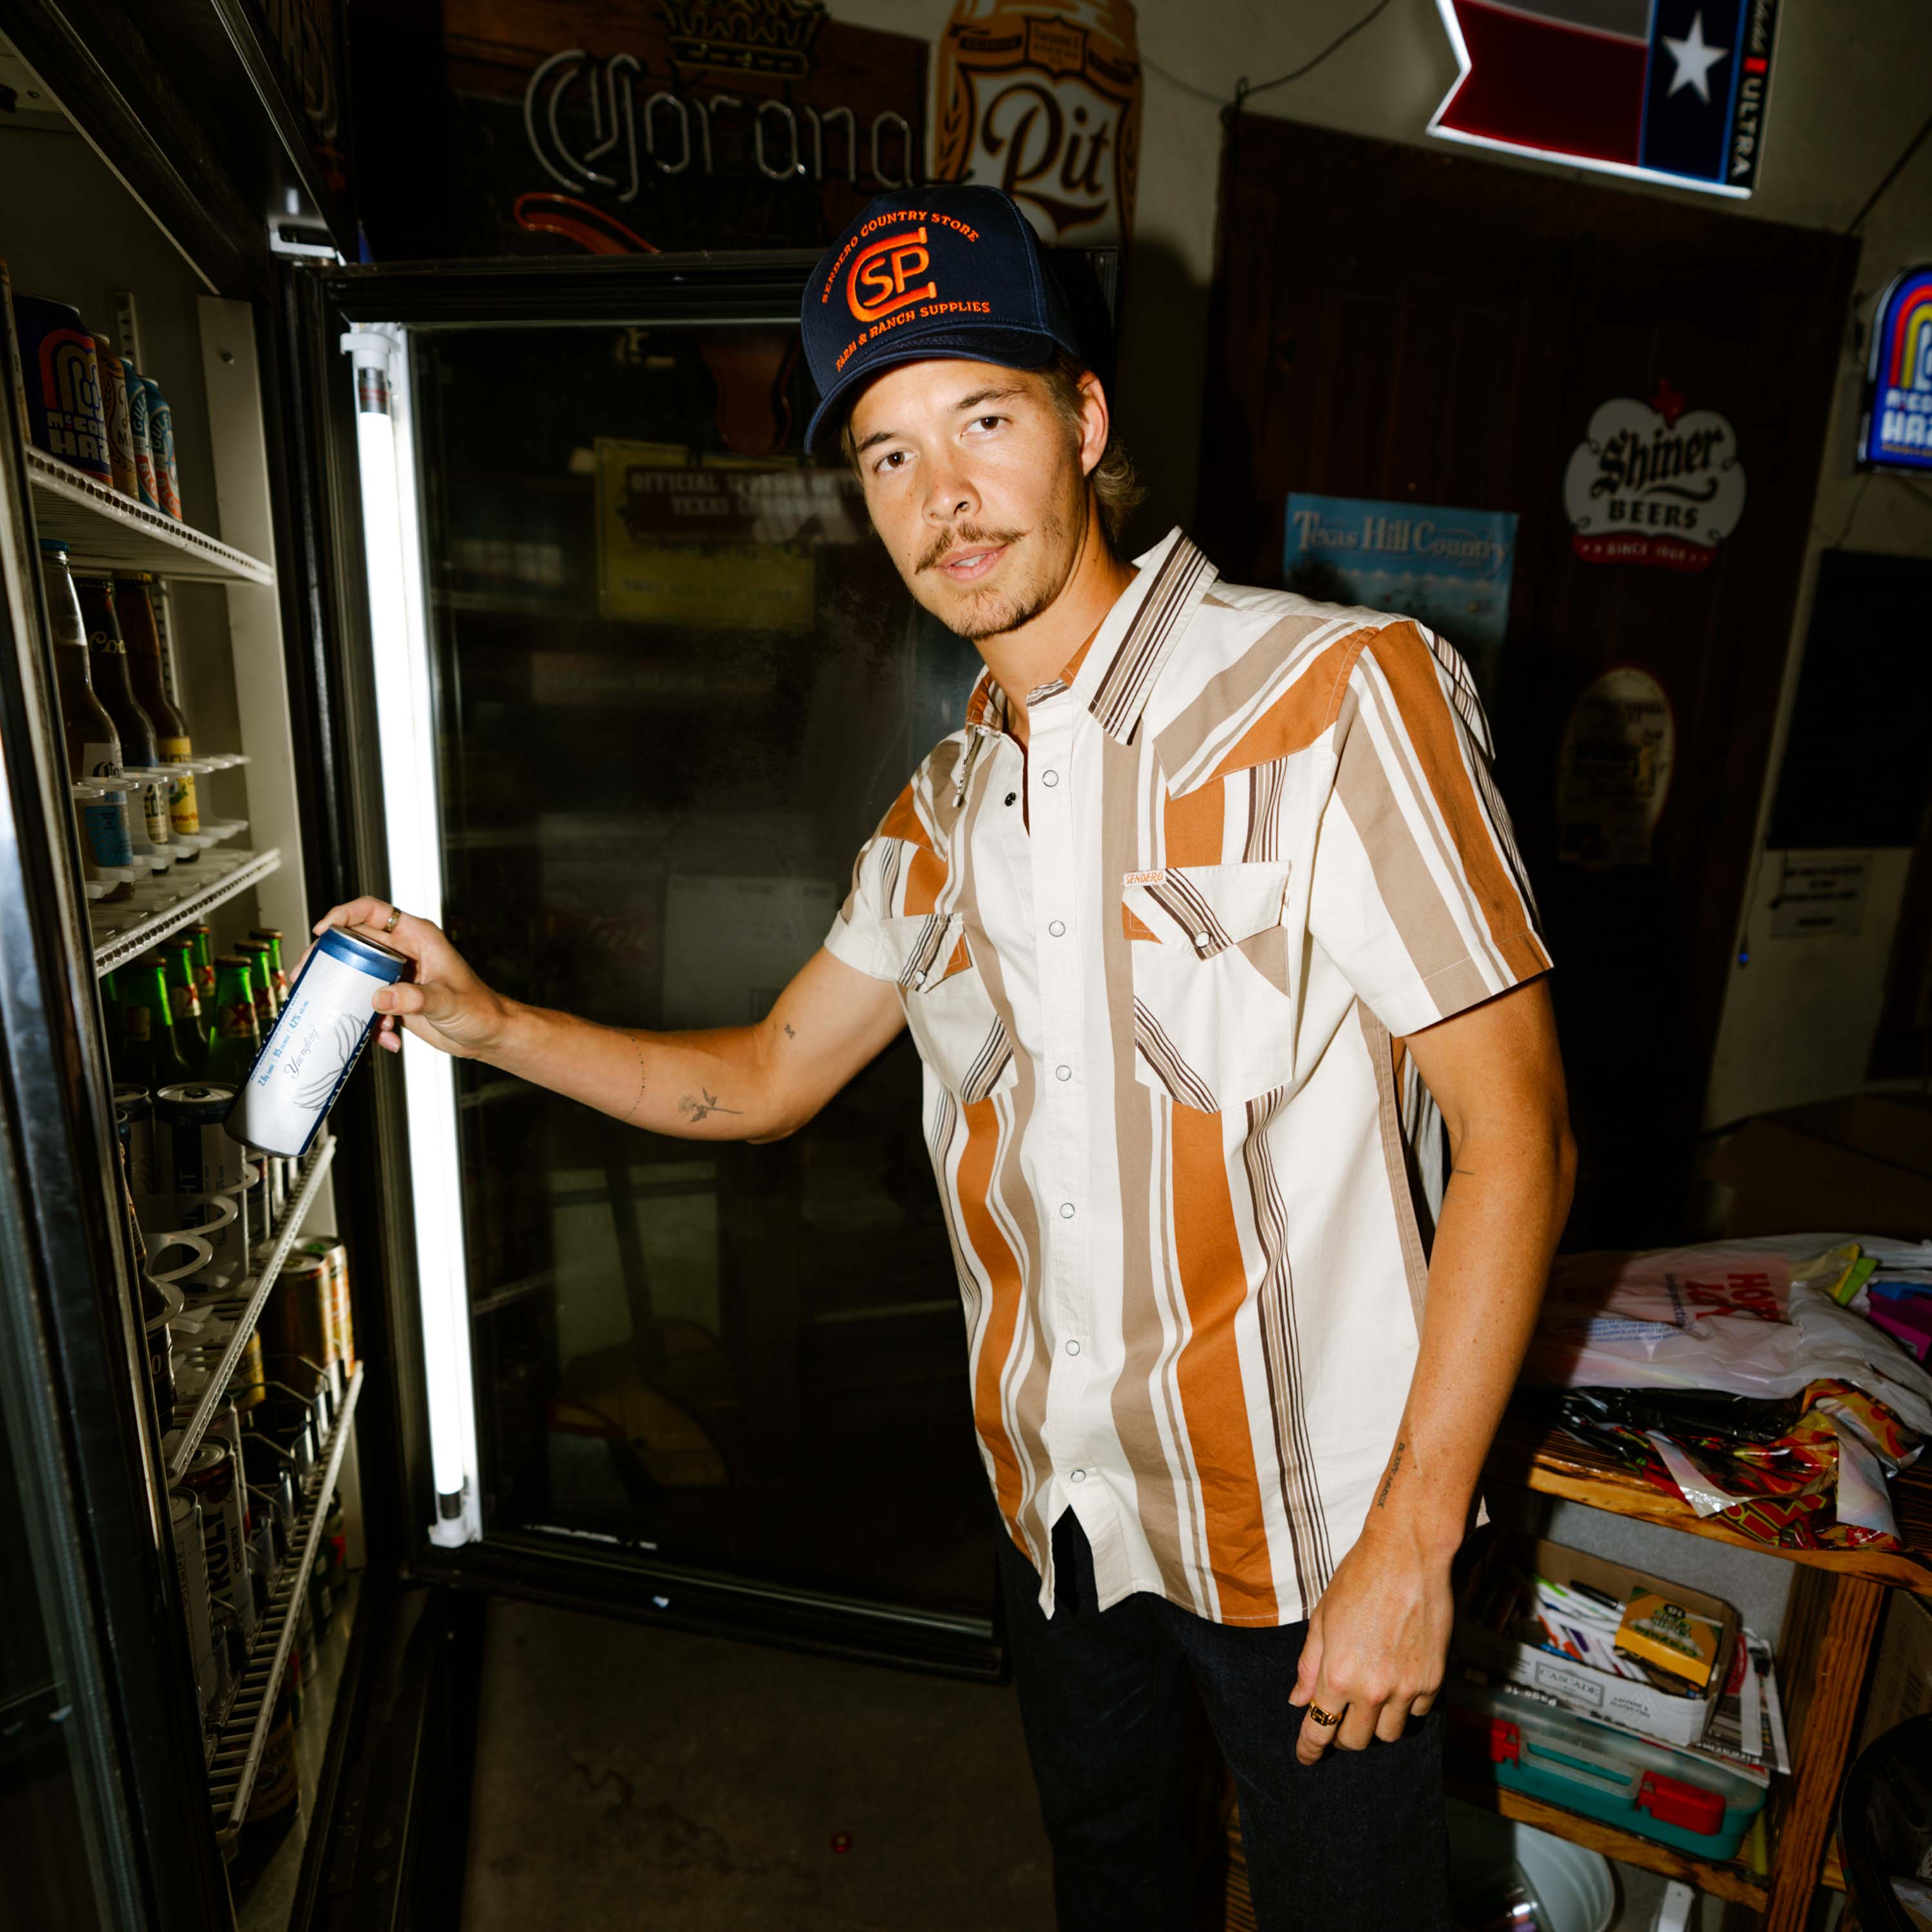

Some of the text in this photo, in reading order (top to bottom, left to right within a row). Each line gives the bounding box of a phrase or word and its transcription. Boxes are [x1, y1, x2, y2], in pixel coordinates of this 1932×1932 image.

[524, 49, 914, 202] Corona
[981, 83, 1110, 196] Pit
[1731, 76, 1764, 178] ULTRA
[822, 211, 980, 304] SENDERO COUNTRY STORE
[836, 301, 990, 372] FARM & RANCH SUPPLIES
[1589, 428, 1725, 500] Shiner
[1293, 509, 1508, 578] Texas Hill Country
[1609, 501, 1698, 529] BEERS
[1126, 871, 1163, 884] SENDERO
[283, 1024, 319, 1079] Yuengling
[1540, 1668, 1600, 1696] CASCADE
